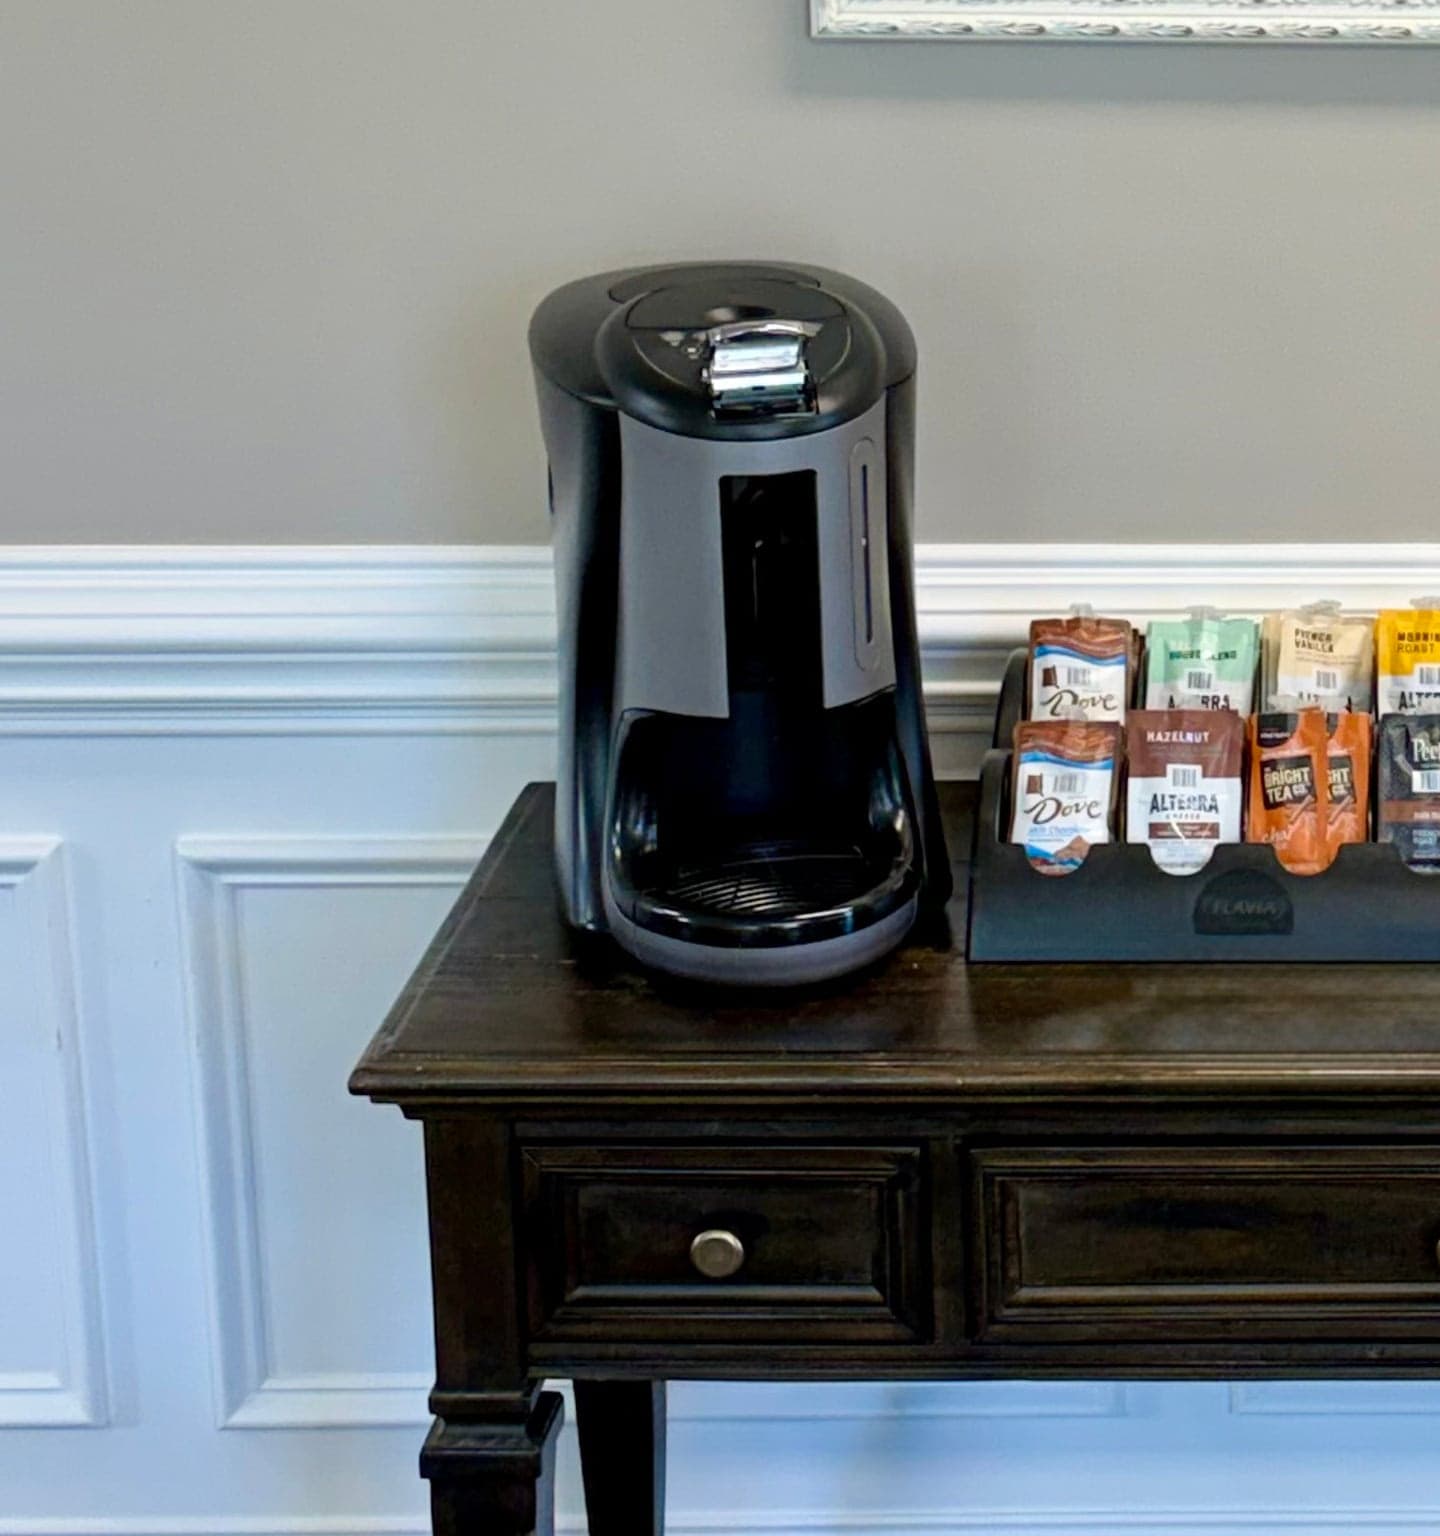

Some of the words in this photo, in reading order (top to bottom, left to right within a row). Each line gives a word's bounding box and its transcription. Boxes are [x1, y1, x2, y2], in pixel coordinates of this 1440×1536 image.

[1146, 730, 1210, 744] HAZELNUT
[1267, 784, 1292, 805] TEA
[1024, 796, 1102, 825] Dove
